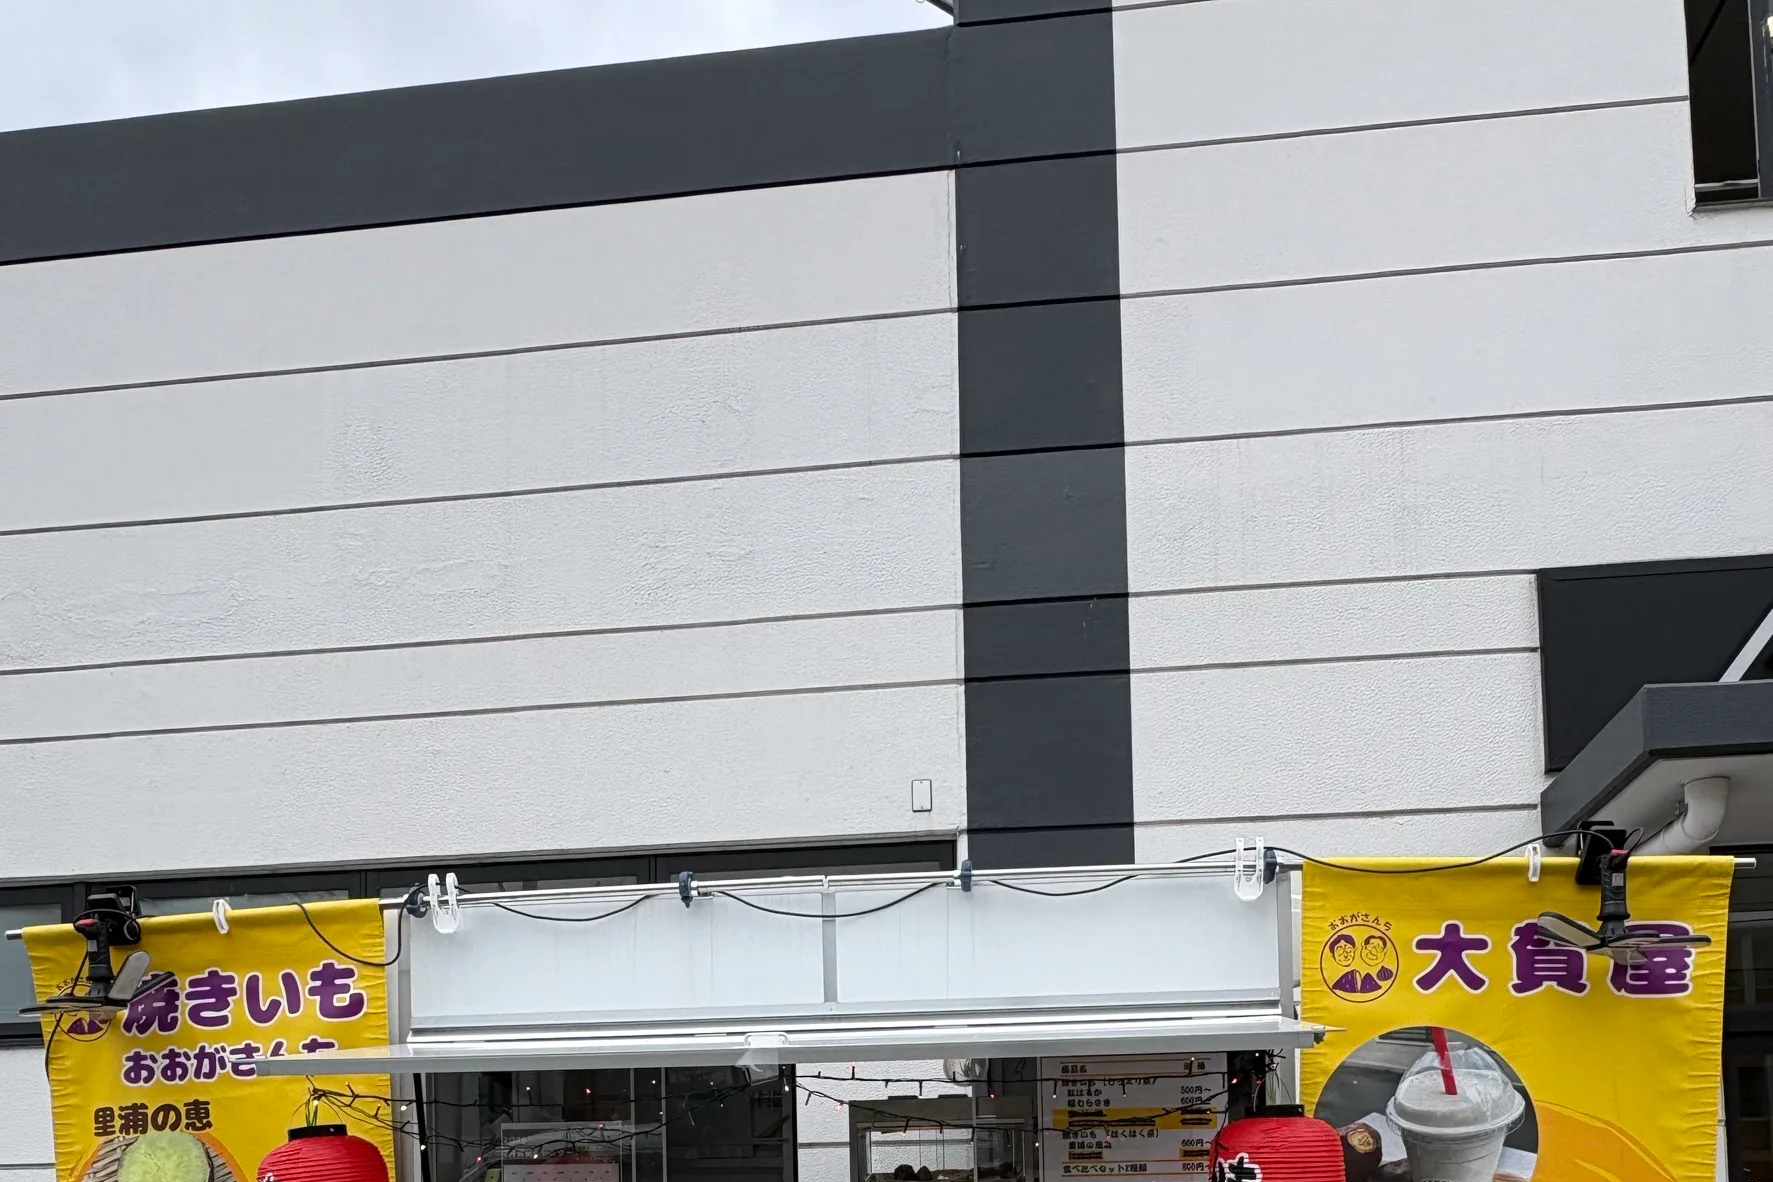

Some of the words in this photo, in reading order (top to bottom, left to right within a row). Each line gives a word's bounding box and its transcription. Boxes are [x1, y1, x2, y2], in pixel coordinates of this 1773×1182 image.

[1328, 911, 1393, 932] おおがさんち
[1411, 919, 1698, 998] 大賀屋
[122, 960, 366, 1035] 焼きいも
[93, 1098, 213, 1137] 里浦の恵
